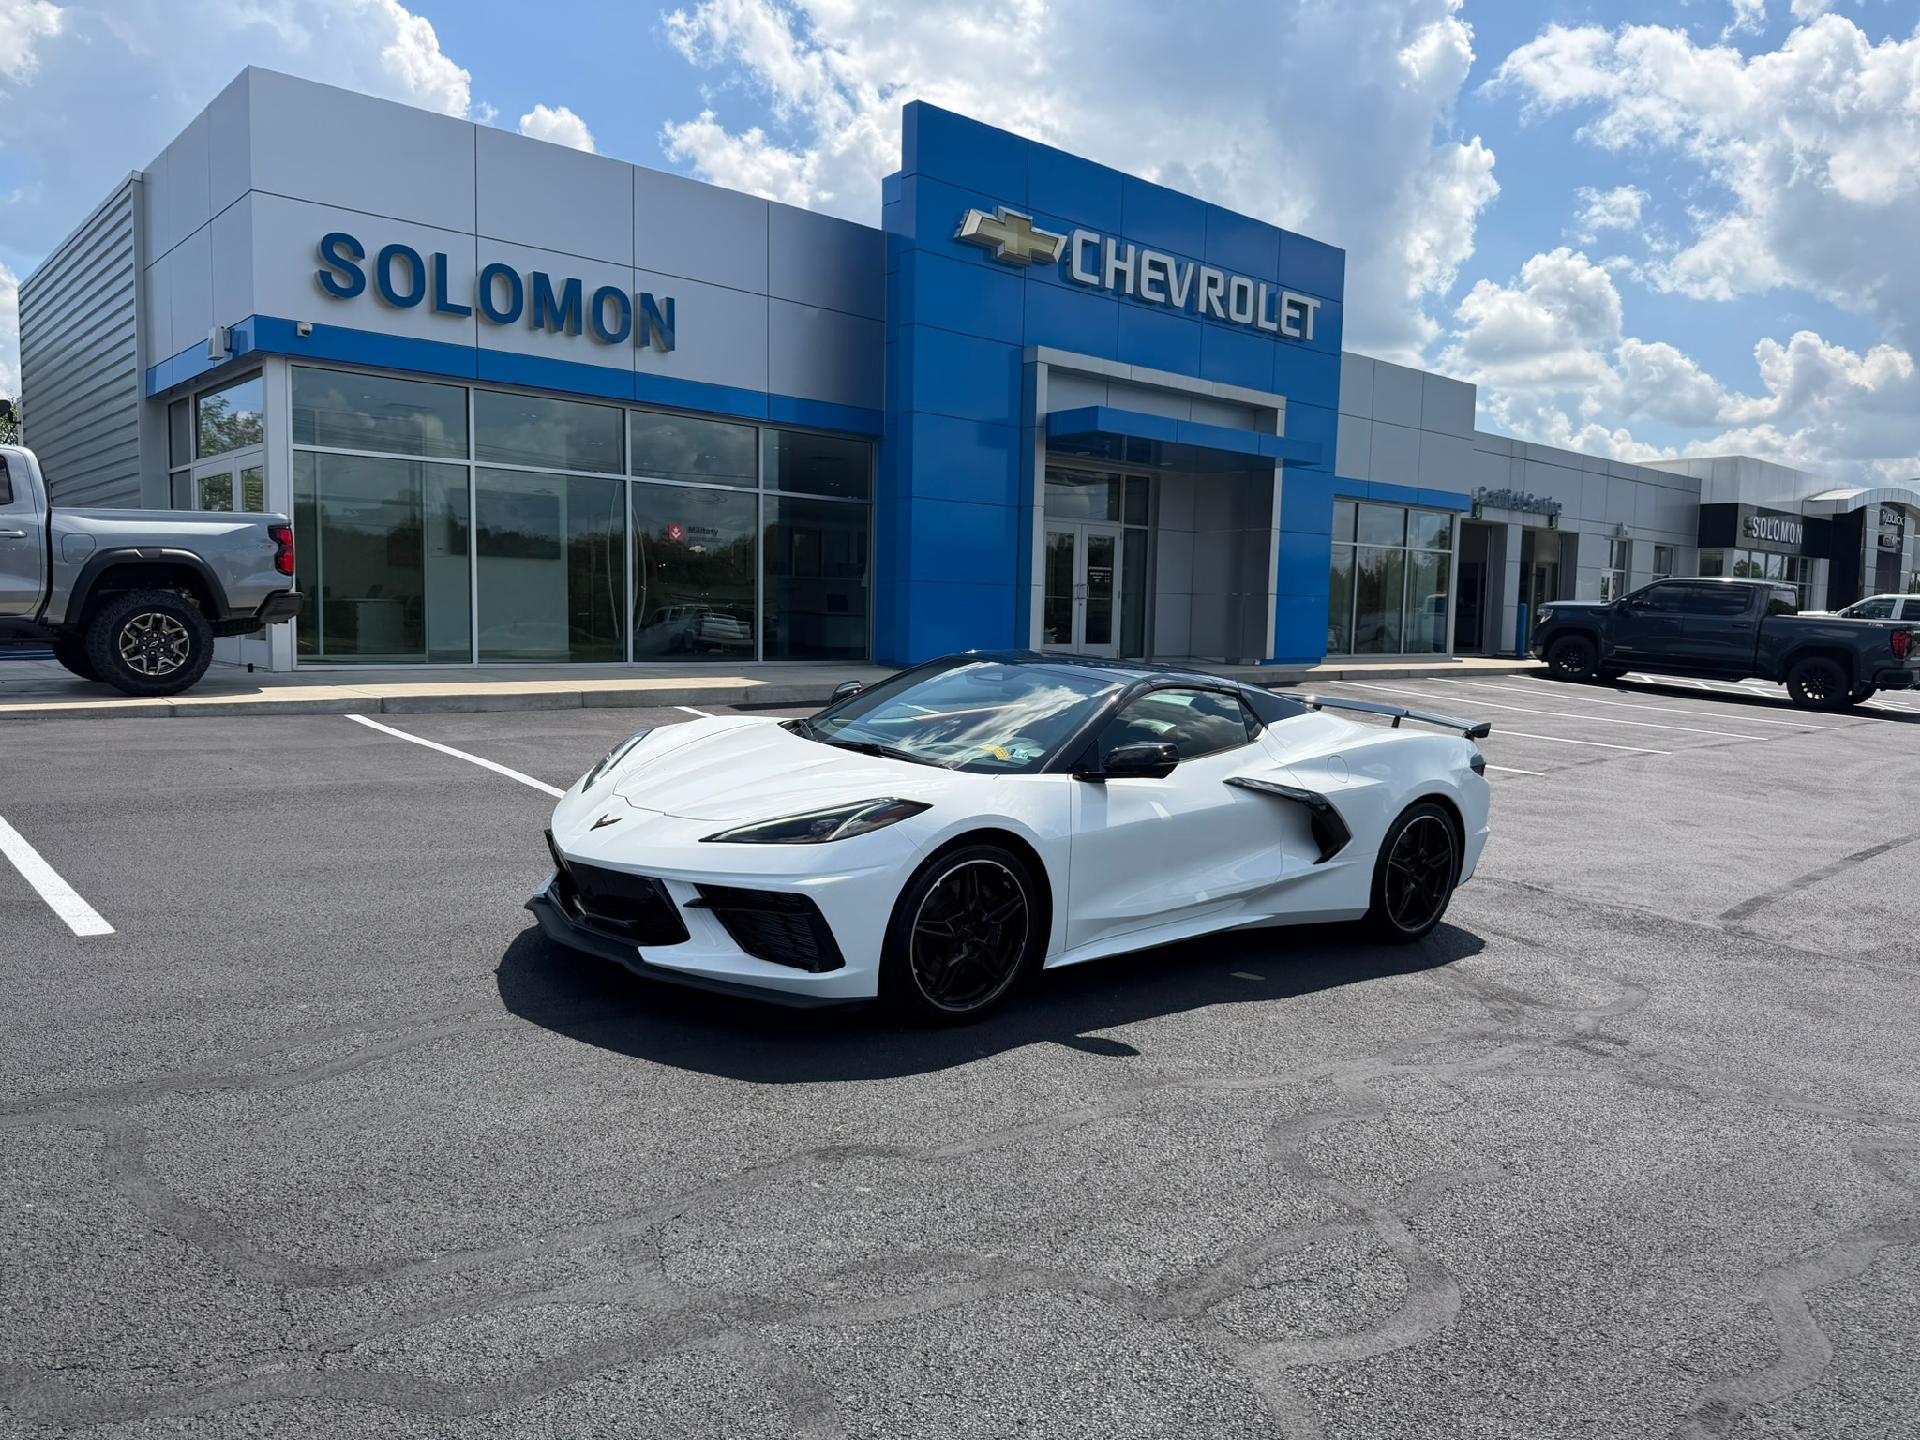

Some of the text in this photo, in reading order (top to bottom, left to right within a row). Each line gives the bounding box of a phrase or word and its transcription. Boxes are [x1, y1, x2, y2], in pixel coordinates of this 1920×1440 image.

[317, 232, 675, 351] SOLOMON
[1072, 229, 1321, 340] CHEVROLET
[1752, 516, 1803, 544] SOLOMON
